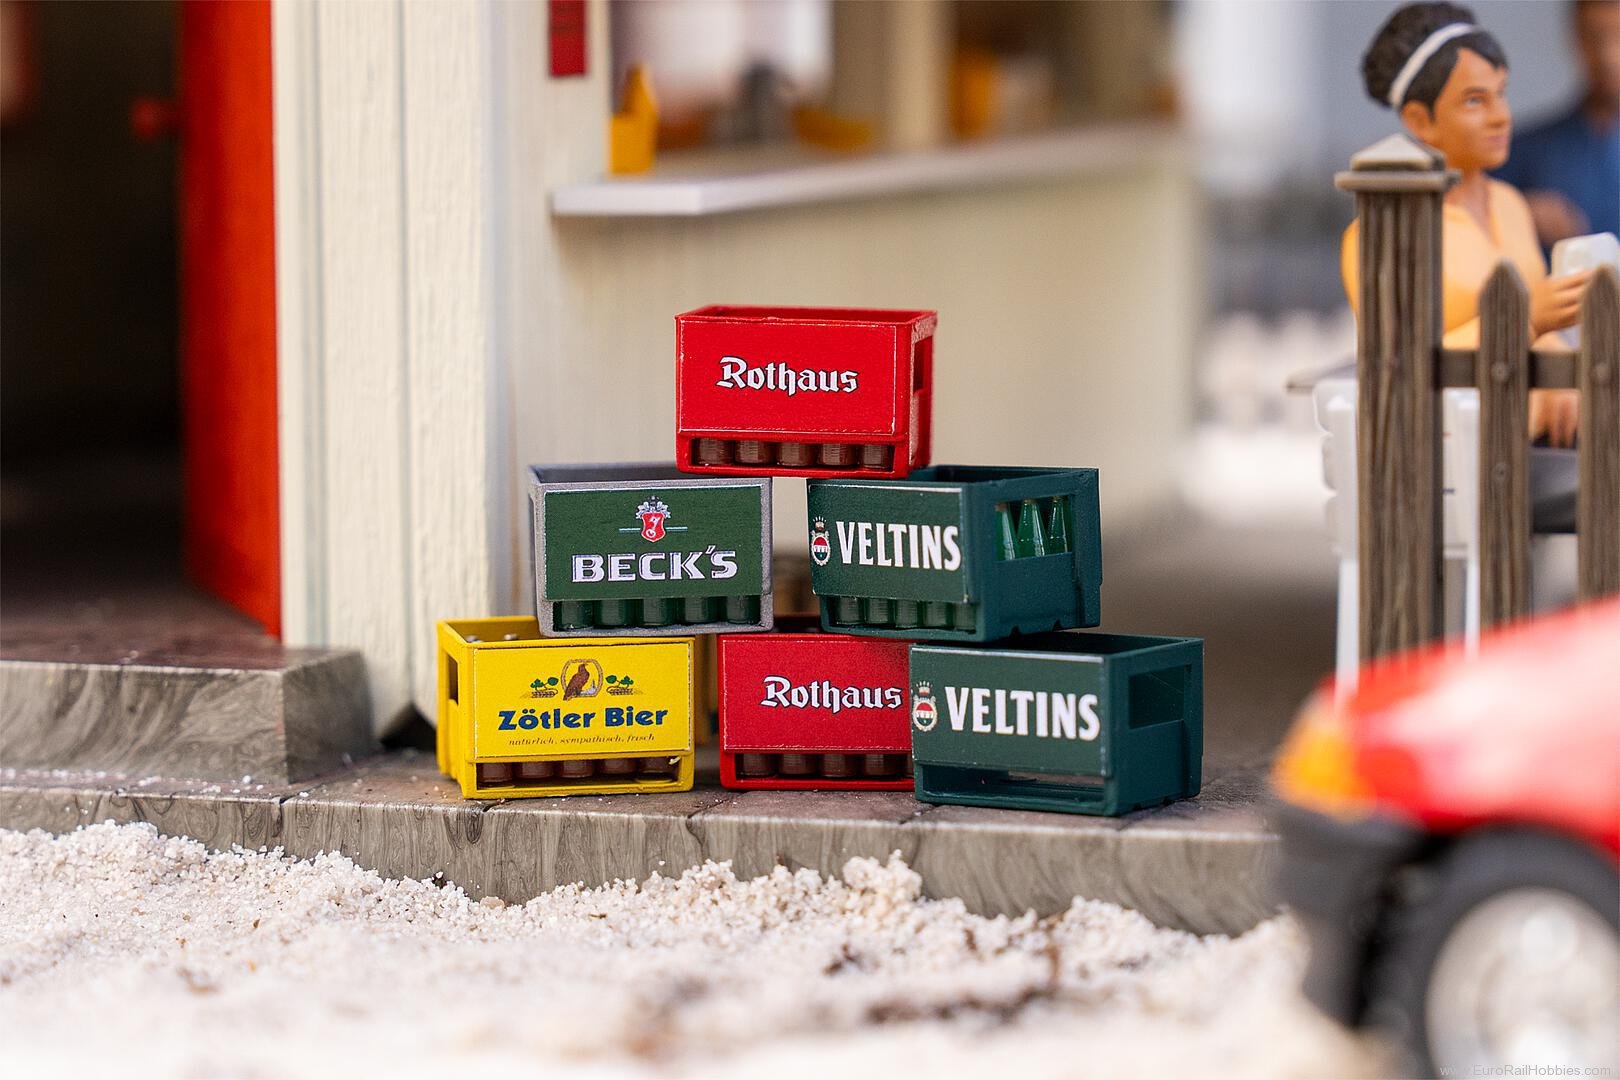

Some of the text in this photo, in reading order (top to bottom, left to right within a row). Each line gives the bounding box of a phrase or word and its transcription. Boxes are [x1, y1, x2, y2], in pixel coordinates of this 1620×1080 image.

[715, 355, 859, 397] Rothaus
[571, 545, 739, 583] BECK'S
[835, 520, 962, 572] VELTINS
[760, 675, 903, 714] Rothaus
[944, 685, 1100, 741] VELTINS
[498, 706, 669, 731] Zötler Bier
[626, 733, 655, 743] frisch
